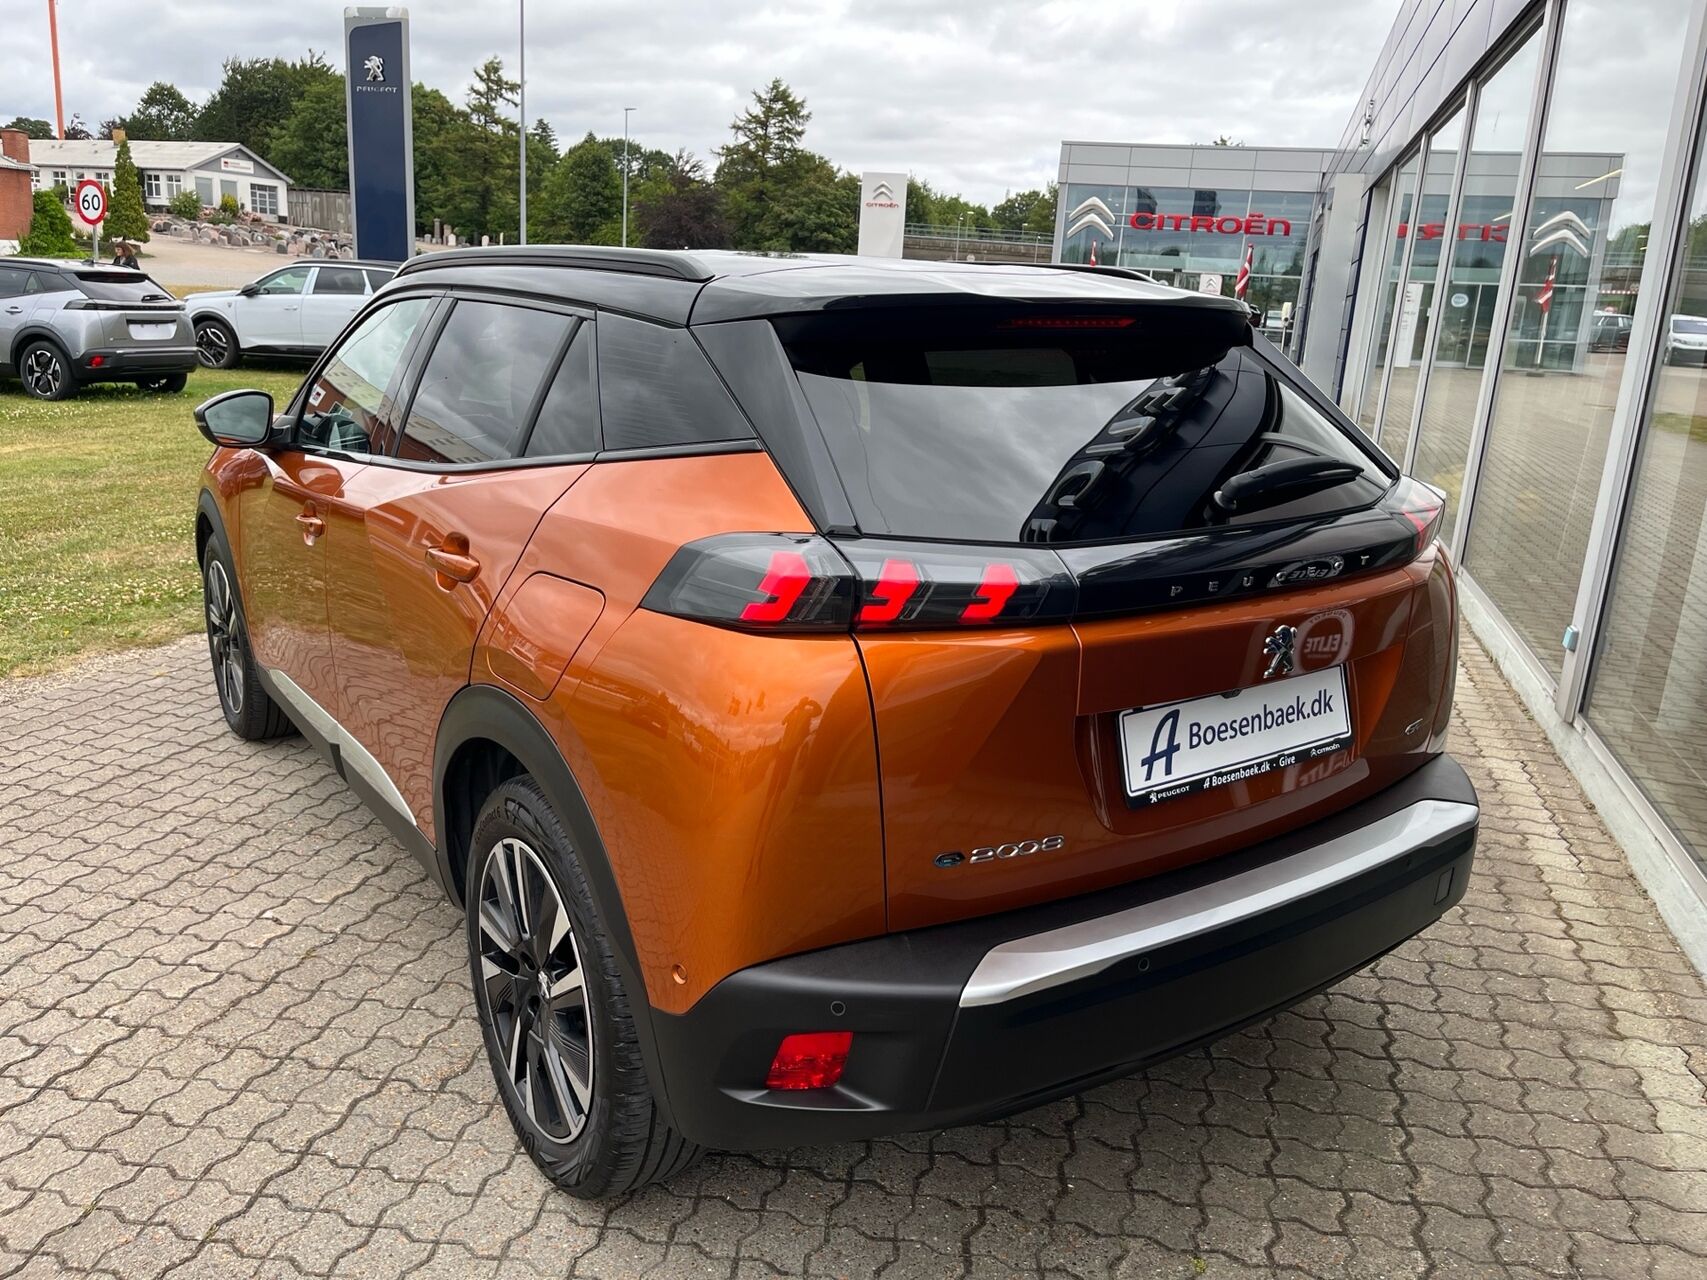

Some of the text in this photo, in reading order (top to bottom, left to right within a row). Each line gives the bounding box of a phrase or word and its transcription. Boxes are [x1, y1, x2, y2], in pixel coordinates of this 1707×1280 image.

[82, 194, 100, 210] 60
[1129, 212, 1292, 236] CITROËN
[1170, 555, 1370, 596] PEUGEOT
[1188, 689, 1334, 750] Boesenbaek.dk
[1212, 761, 1271, 786] Boesenbaek.dk
[1279, 754, 1296, 767] Give
[1158, 785, 1190, 800] PEUGEOT
[969, 835, 1064, 864] 2008
